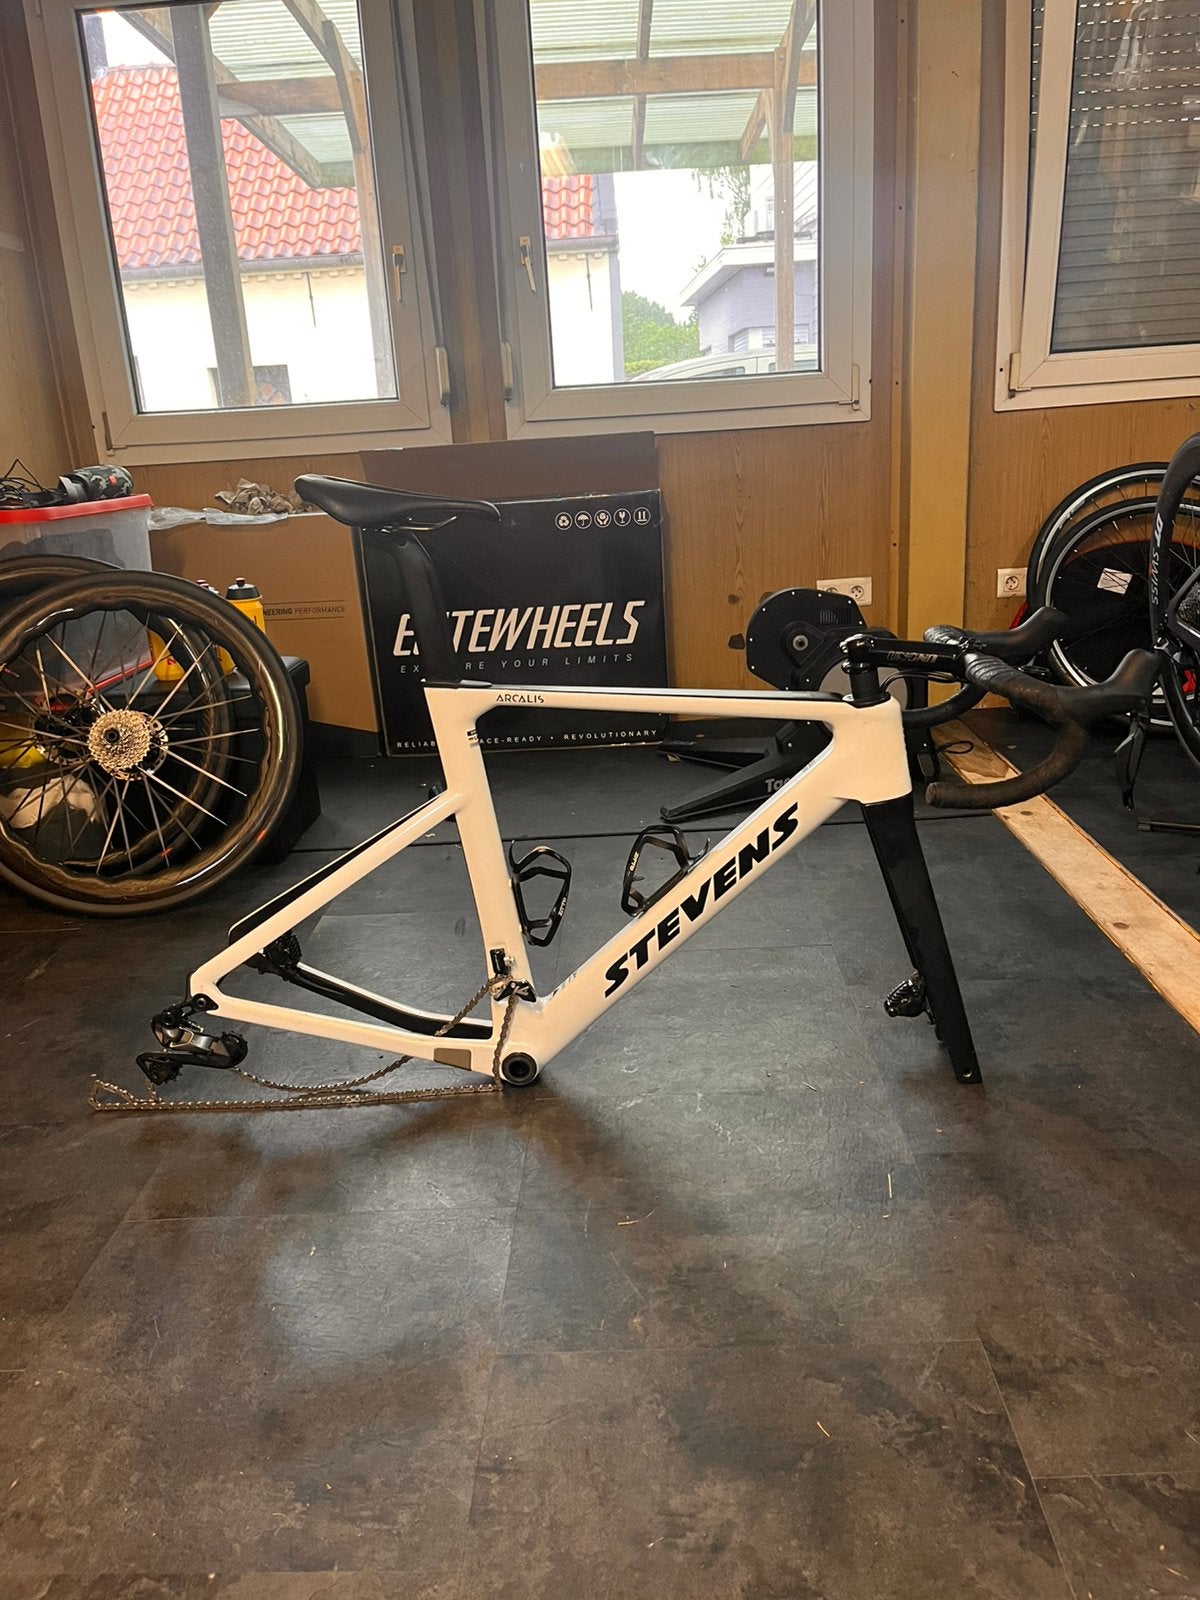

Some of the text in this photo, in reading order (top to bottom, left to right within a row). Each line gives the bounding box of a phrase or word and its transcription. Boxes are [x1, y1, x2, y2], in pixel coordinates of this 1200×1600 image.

[1151, 547, 1160, 605] SWISS
[294, 605, 345, 615] PERFORMANCE
[393, 600, 646, 656] ETEWHEELS
[400, 653, 632, 673] EXRE YOUR LIMITS
[496, 694, 545, 703] ARCALIS
[396, 740, 436, 748] RELIAB
[479, 735, 542, 745] ACE-READY
[563, 729, 657, 740] REVOLUTIONARY
[605, 802, 799, 998] STEVENS
